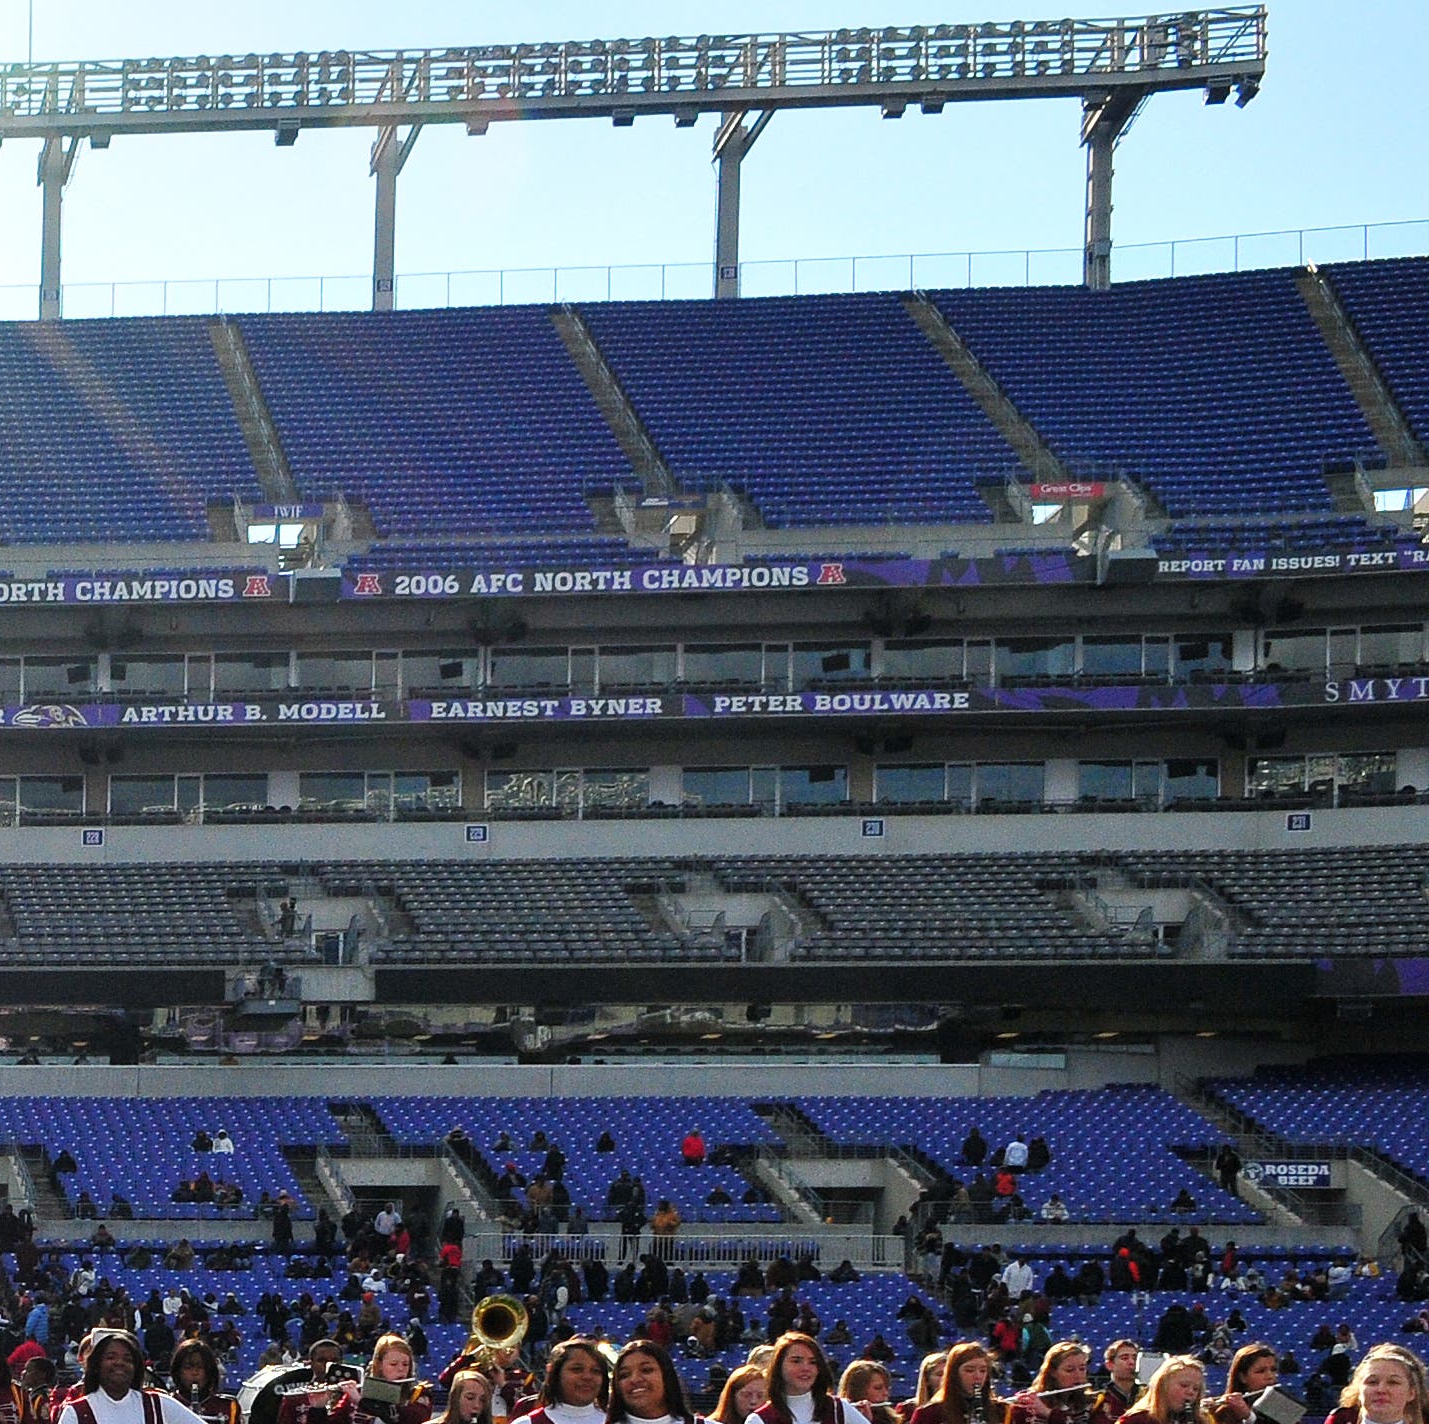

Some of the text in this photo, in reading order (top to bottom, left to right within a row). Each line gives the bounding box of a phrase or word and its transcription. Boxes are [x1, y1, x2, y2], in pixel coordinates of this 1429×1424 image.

[274, 506, 303, 517] IWIF
[1159, 559, 1224, 573] REPORT
[1233, 558, 1265, 571] FAN
[1271, 556, 1340, 570] ISSUES!
[1347, 552, 1397, 566] TEXT
[75, 579, 234, 600] CHAMPIONS
[395, 575, 459, 595] 2006
[470, 573, 523, 593] AFC
[533, 571, 632, 592] NORTH
[643, 567, 808, 589] CHAMPIONS
[122, 702, 385, 722] ARTHUR B. MODELL
[431, 698, 662, 718] EARNEST BYNER
[714, 692, 969, 712] PETER BOULWARE
[1265, 1165, 1329, 1175] ROSEDA
[1278, 1176, 1317, 1185] BEEF
